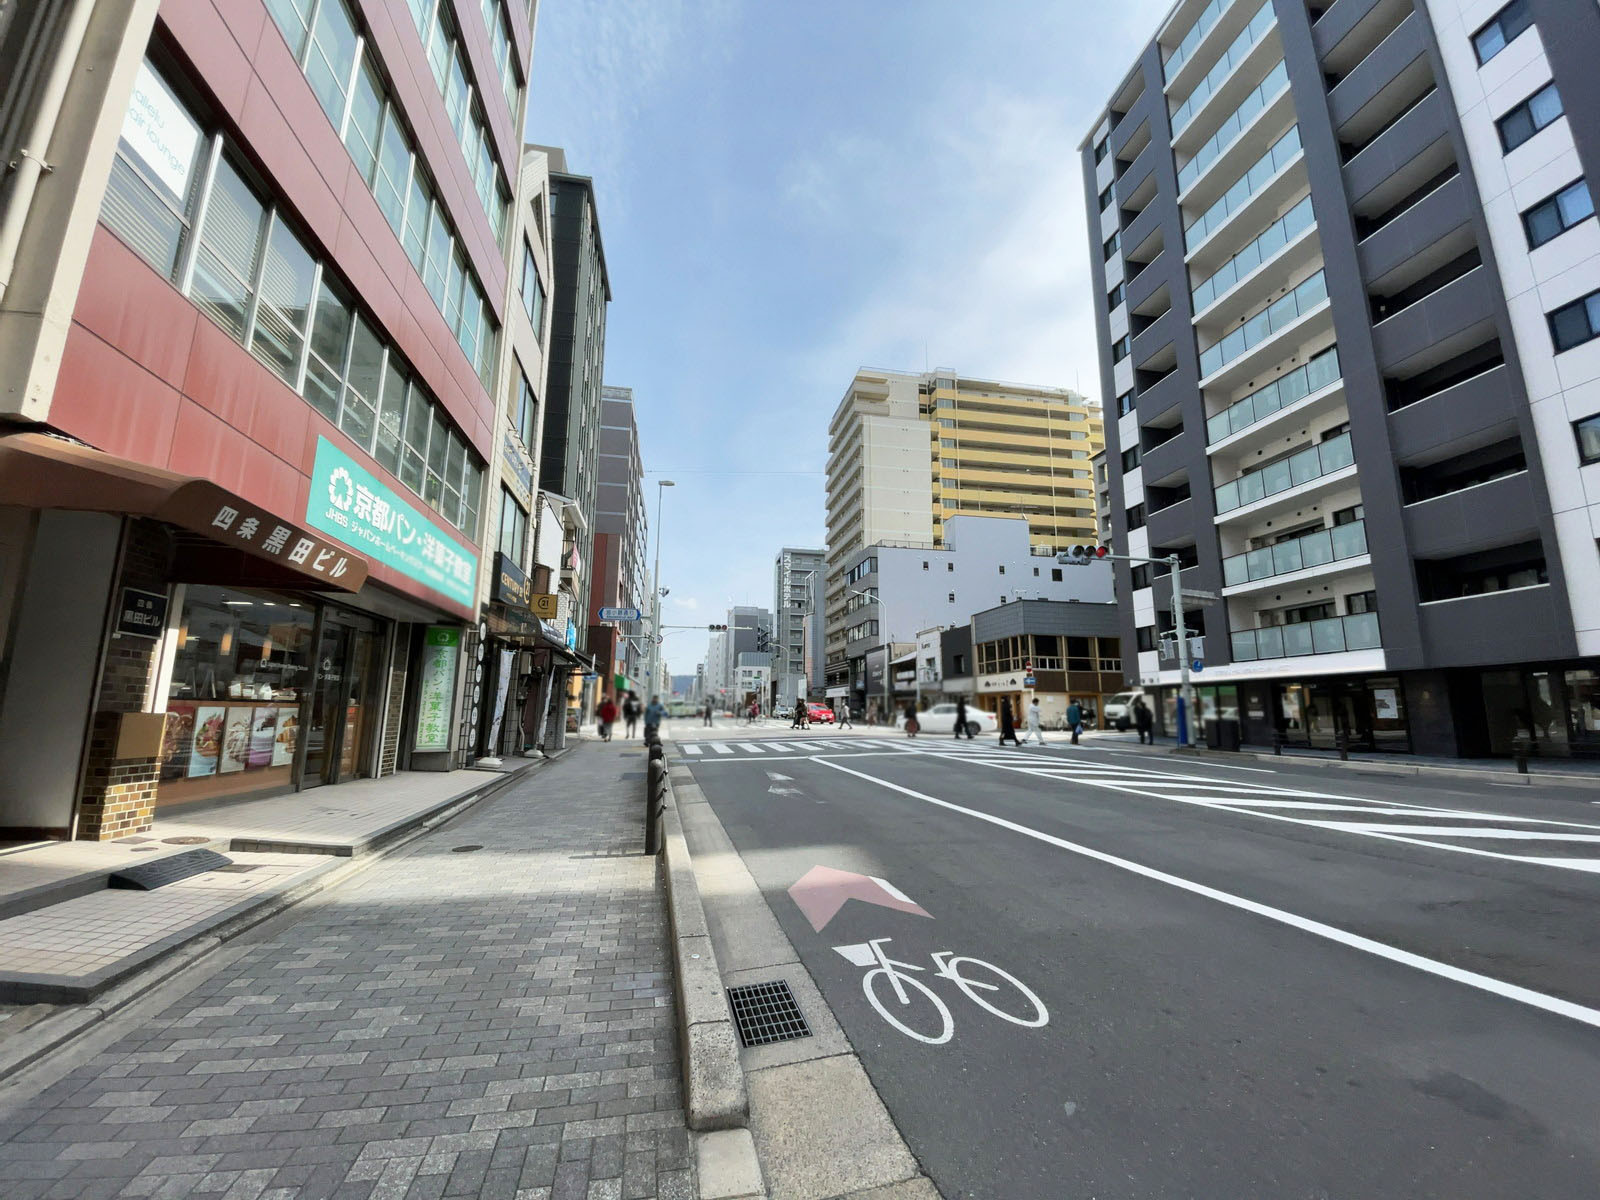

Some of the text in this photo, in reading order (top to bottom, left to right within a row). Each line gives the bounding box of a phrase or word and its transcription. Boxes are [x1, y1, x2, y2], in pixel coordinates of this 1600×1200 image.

[132, 88, 165, 129] allelu
[145, 123, 185, 176] lounge
[325, 508, 350, 529] JHBS
[783, 554, 791, 609] スマイルホテル
[123, 610, 161, 627] 黒田ビル
